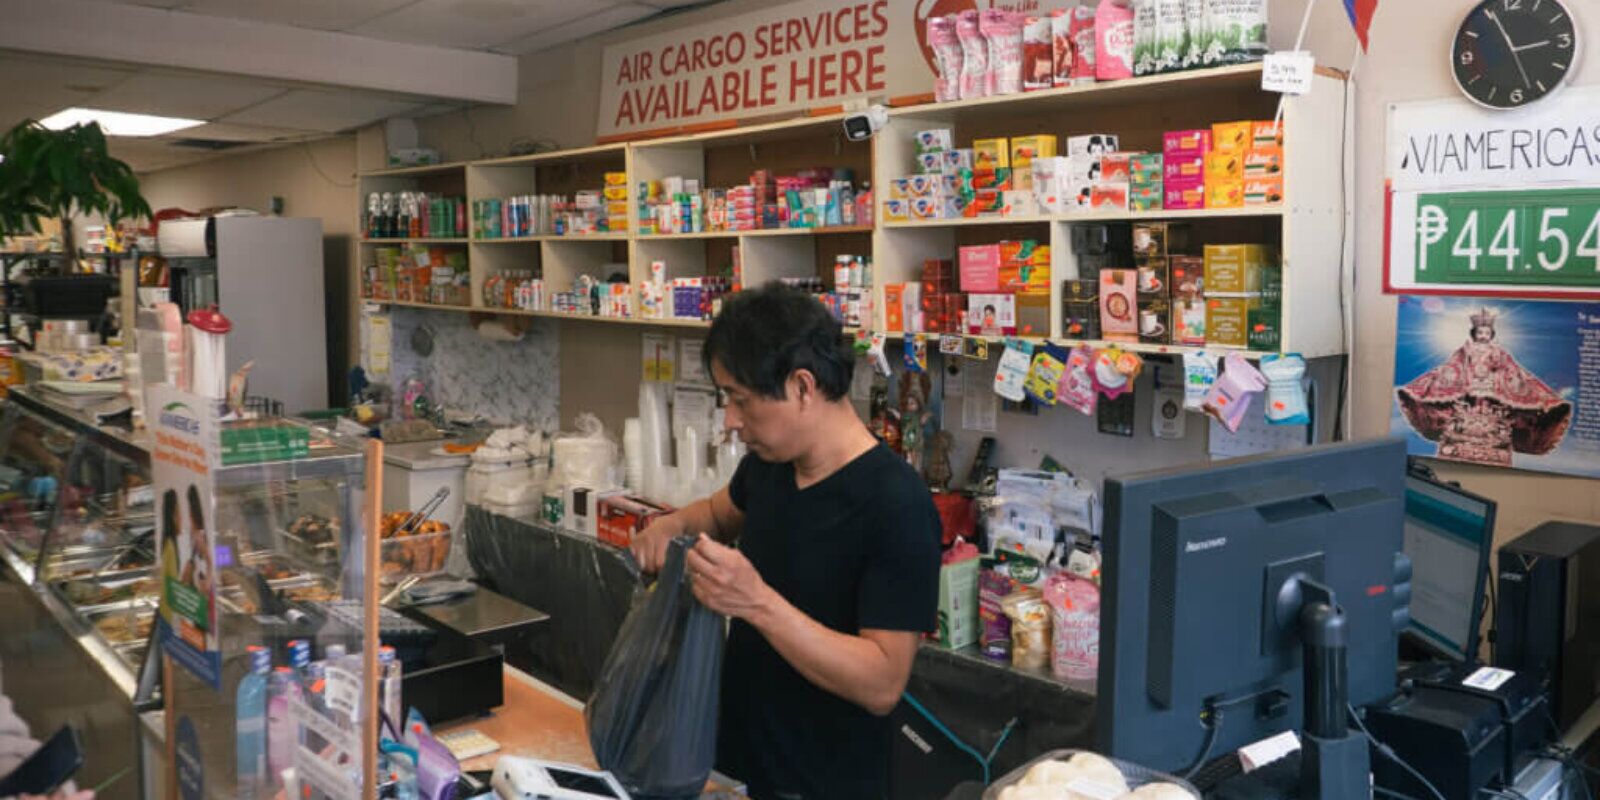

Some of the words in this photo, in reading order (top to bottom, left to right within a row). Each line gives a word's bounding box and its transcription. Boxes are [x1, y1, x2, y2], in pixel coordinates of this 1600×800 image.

[1504, 0, 1522, 11] 12
[617, 51, 652, 85] AIR
[660, 32, 746, 76] CARGO
[754, 0, 888, 59] SERVICES
[1557, 33, 1571, 49] 3
[1461, 51, 1473, 65] 9
[615, 64, 778, 127] AVAILABLE
[790, 45, 886, 102] HERE
[1510, 89, 1523, 103] 6
